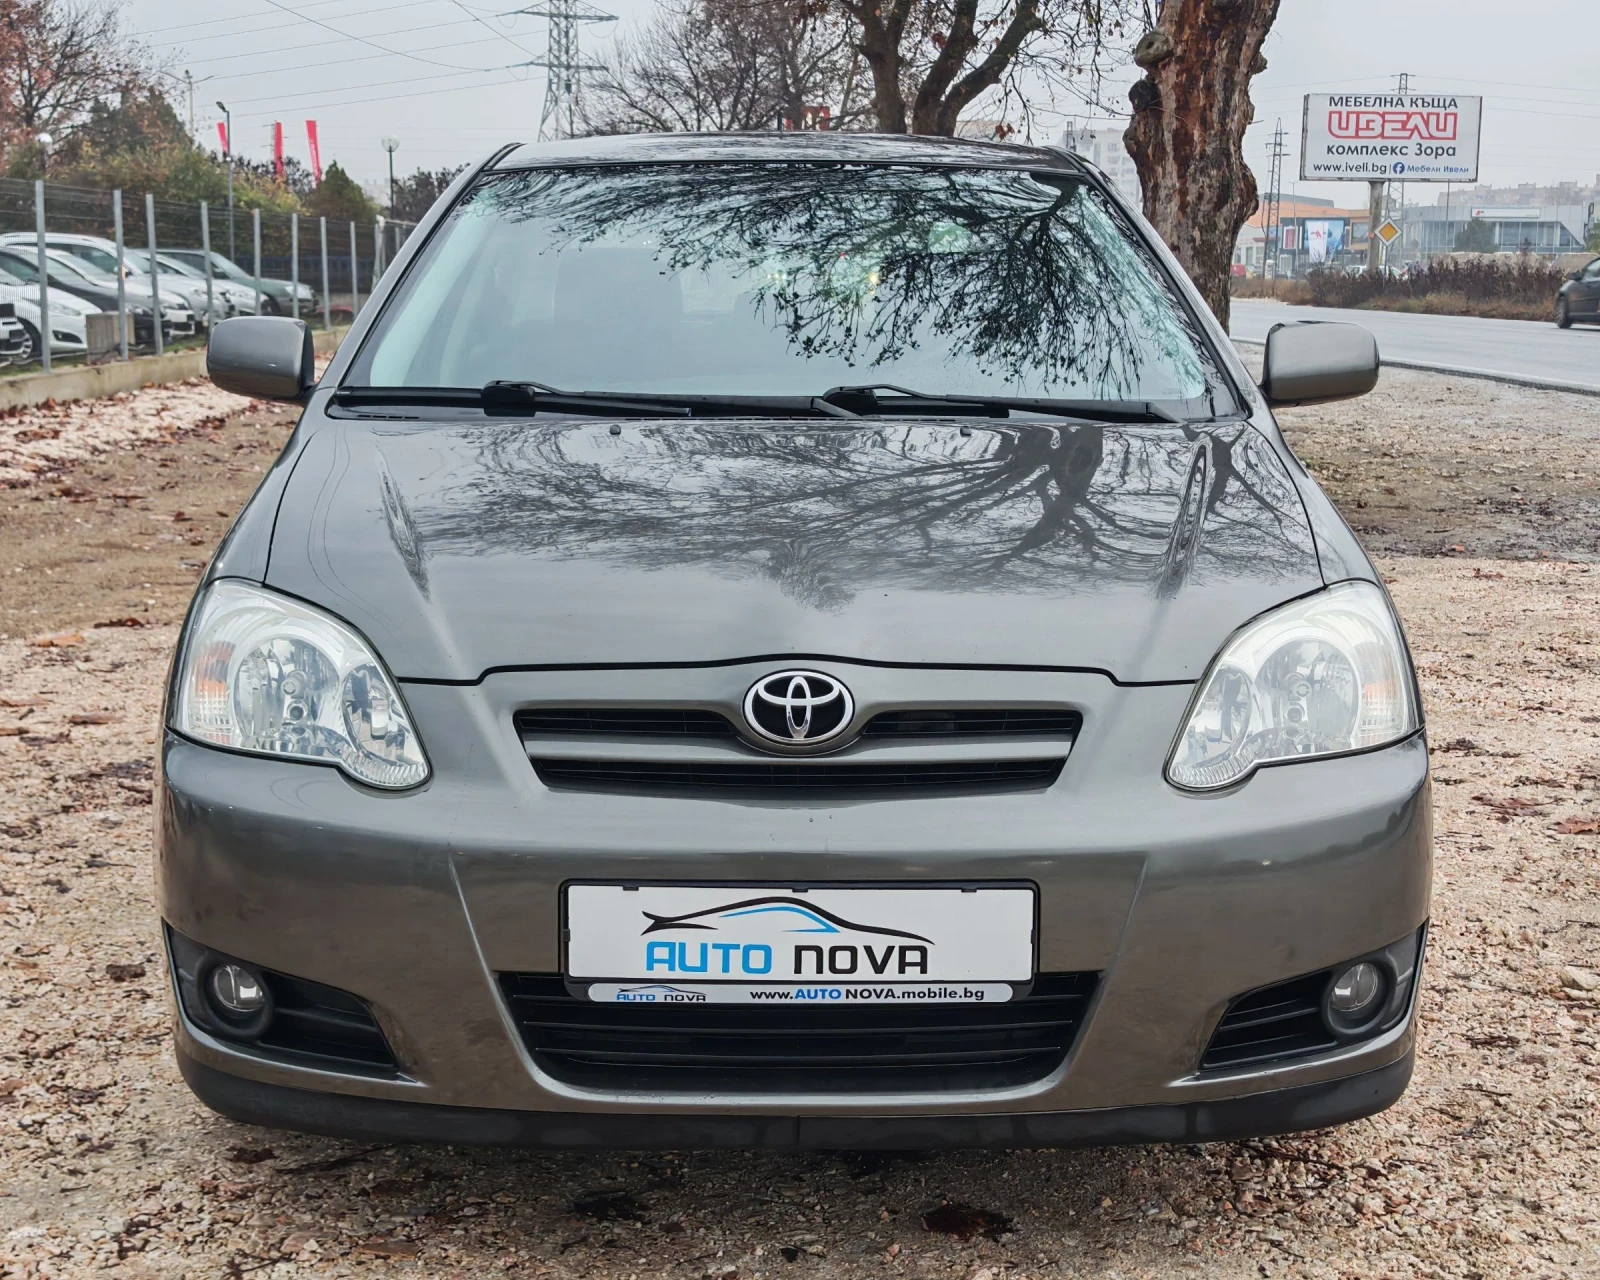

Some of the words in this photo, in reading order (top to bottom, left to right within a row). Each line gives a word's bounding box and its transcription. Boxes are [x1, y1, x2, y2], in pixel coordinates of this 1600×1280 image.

[1329, 96, 1405, 108] МЕБЕЛНА
[1409, 97, 1458, 111] КЪЩА
[1328, 111, 1458, 140] ИВЕЛИ
[1326, 145, 1409, 156] комплекс
[1414, 143, 1457, 159] Зора
[1313, 162, 1387, 175] www.iveli.bg
[1406, 164, 1441, 173] Мебели
[1443, 165, 1469, 173] Ивели
[646, 941, 773, 974] AUTO
[793, 945, 928, 974] NOVA
[616, 993, 656, 1002] AUTO
[664, 994, 706, 1002] NOVA
[750, 988, 842, 1000] www.AUTO
[845, 987, 985, 1001] NOVA.mobile.bg
